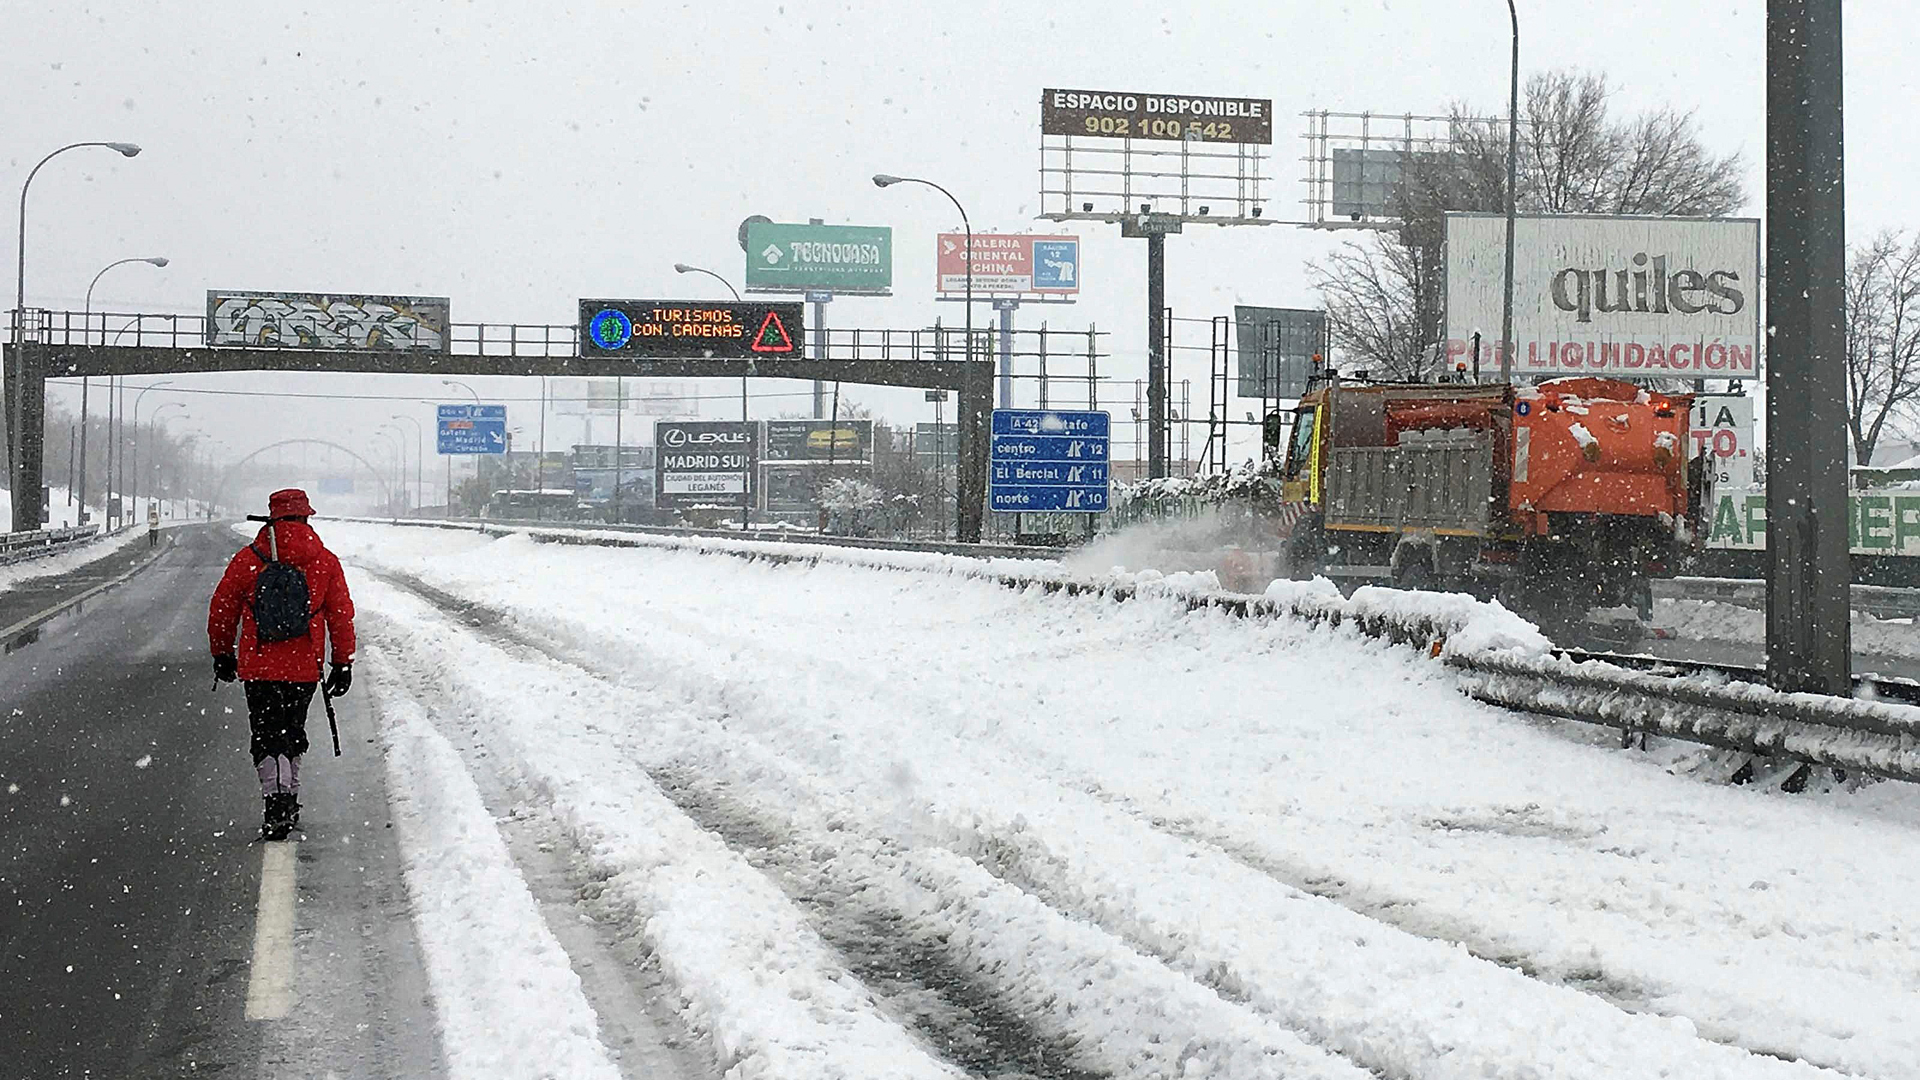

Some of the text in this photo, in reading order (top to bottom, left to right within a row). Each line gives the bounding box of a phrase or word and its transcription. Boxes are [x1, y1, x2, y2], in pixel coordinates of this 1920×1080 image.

[1053, 92, 1262, 118] ESPACIO DISPONIBLE
[1085, 116, 1130, 135] 902
[1137, 118, 1181, 138] 100
[790, 242, 880, 265] TECNOCASA
[959, 251, 1025, 261] ORIENTAL
[972, 263, 1014, 273] CHINA
[1551, 252, 1745, 323] quiles
[652, 308, 733, 323] TURISMOS
[632, 323, 743, 338] CON CADENAS
[1446, 337, 1752, 371] POR LIQUIDACIÓN
[1013, 419, 1039, 429] A-42
[687, 432, 750, 443] LEXUS
[997, 442, 1103, 455] centro 12
[663, 455, 720, 468] MADRID
[996, 467, 1103, 480] El Bercial 11
[995, 493, 1103, 505] norte 10
